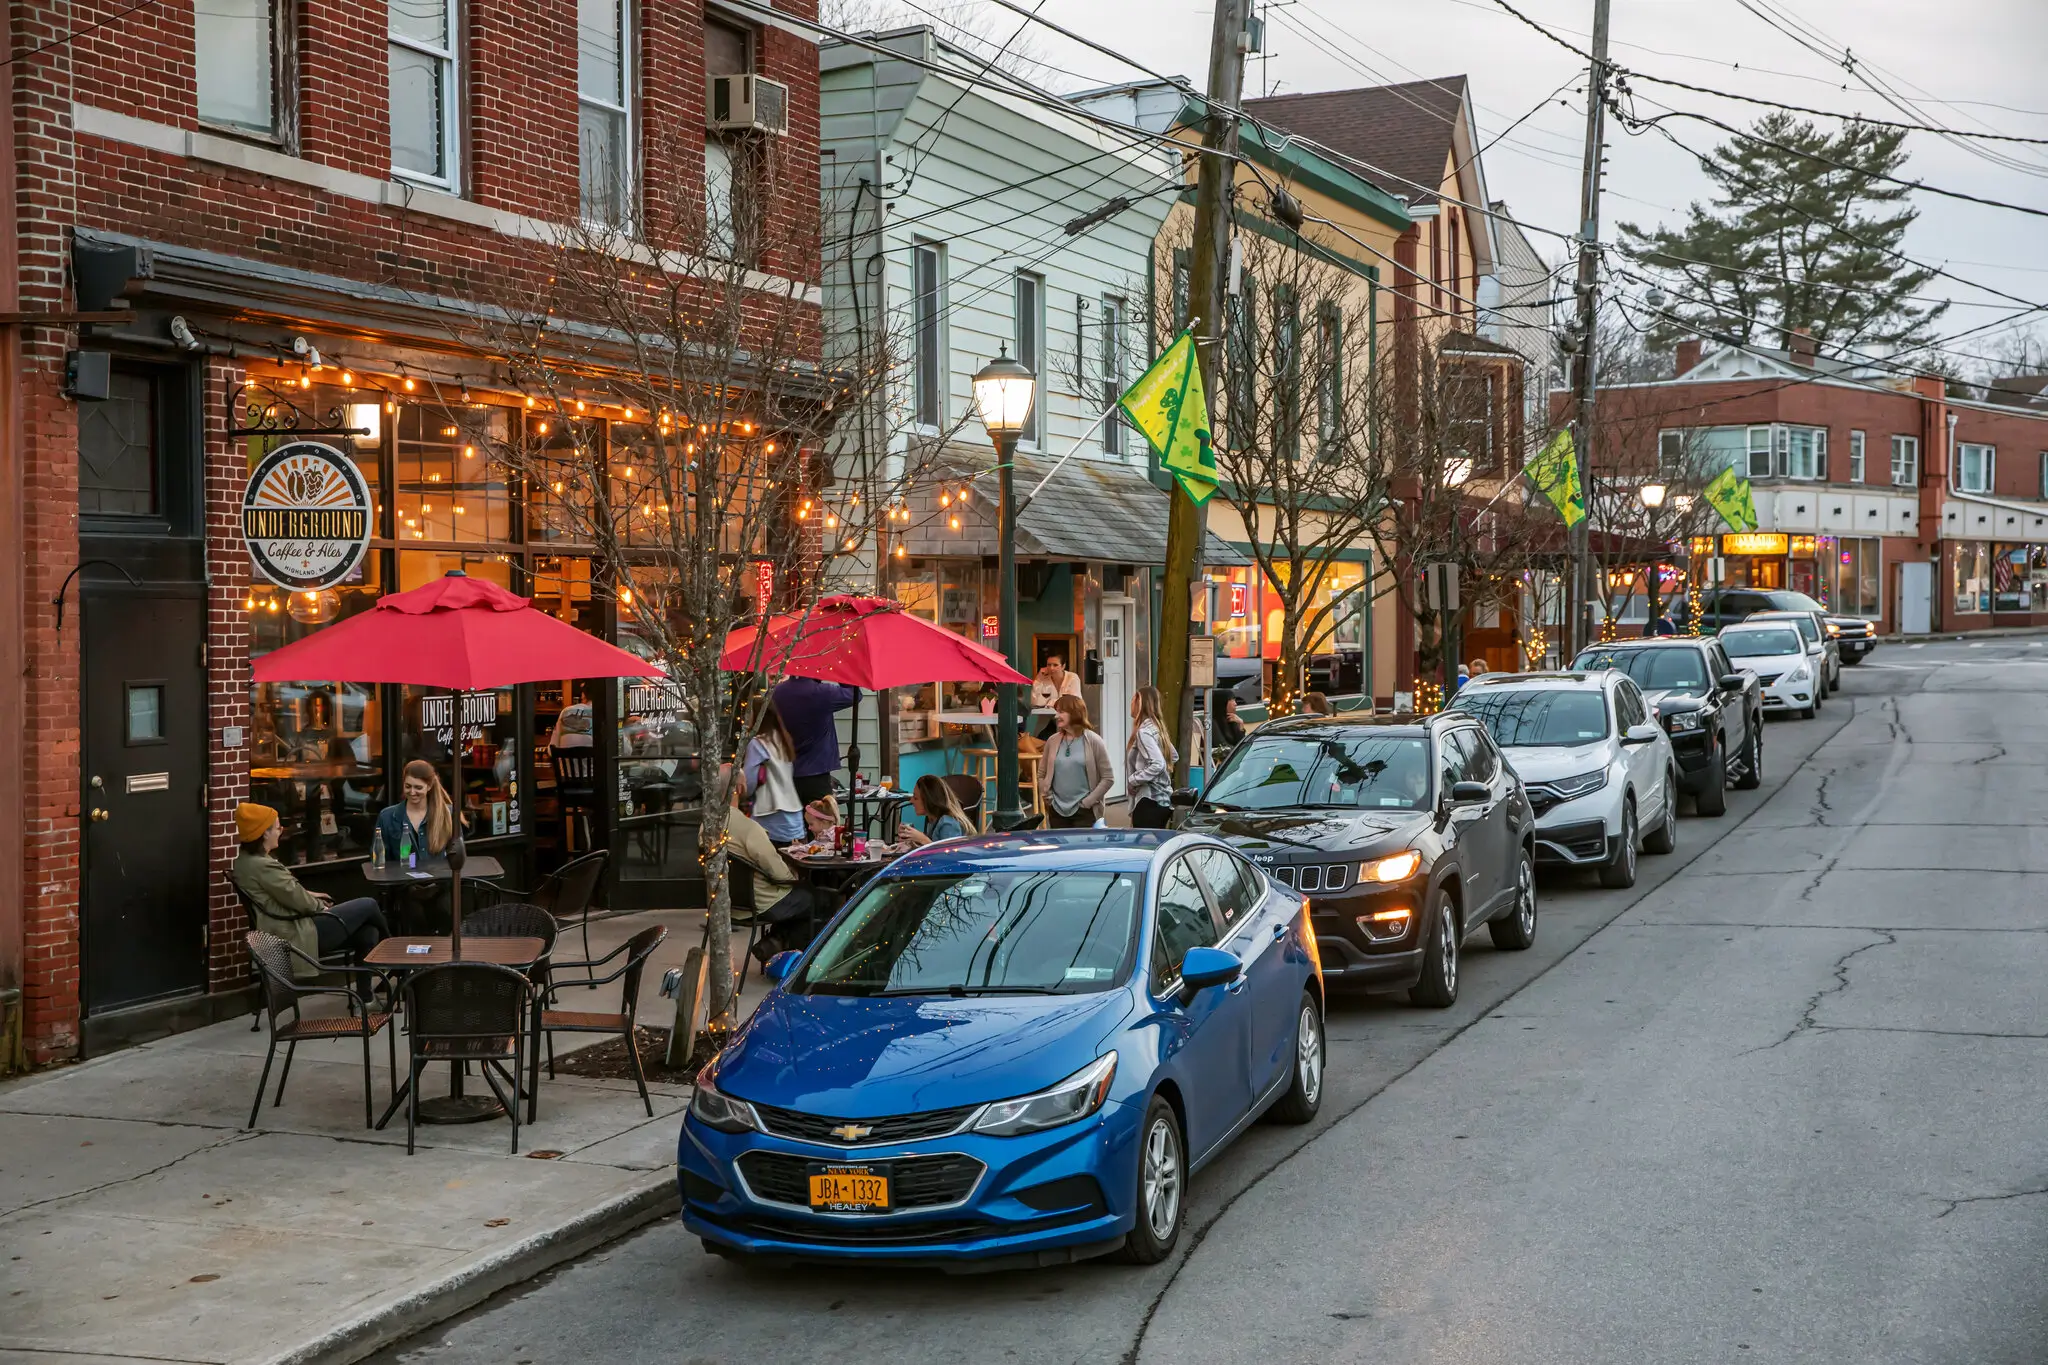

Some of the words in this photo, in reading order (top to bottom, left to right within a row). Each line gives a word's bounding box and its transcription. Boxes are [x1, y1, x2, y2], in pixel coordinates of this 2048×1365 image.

[248, 510, 362, 538] UNDERGROUND
[268, 541, 302, 561] Coffee
[304, 541, 316, 558] &
[316, 542, 343, 558] Ales
[319, 565, 327, 573] NY
[423, 697, 496, 727] UNDEROUND
[437, 727, 454, 745] Coff
[1253, 854, 1274, 863] Jeep
[829, 1203, 868, 1211] HEALEY
